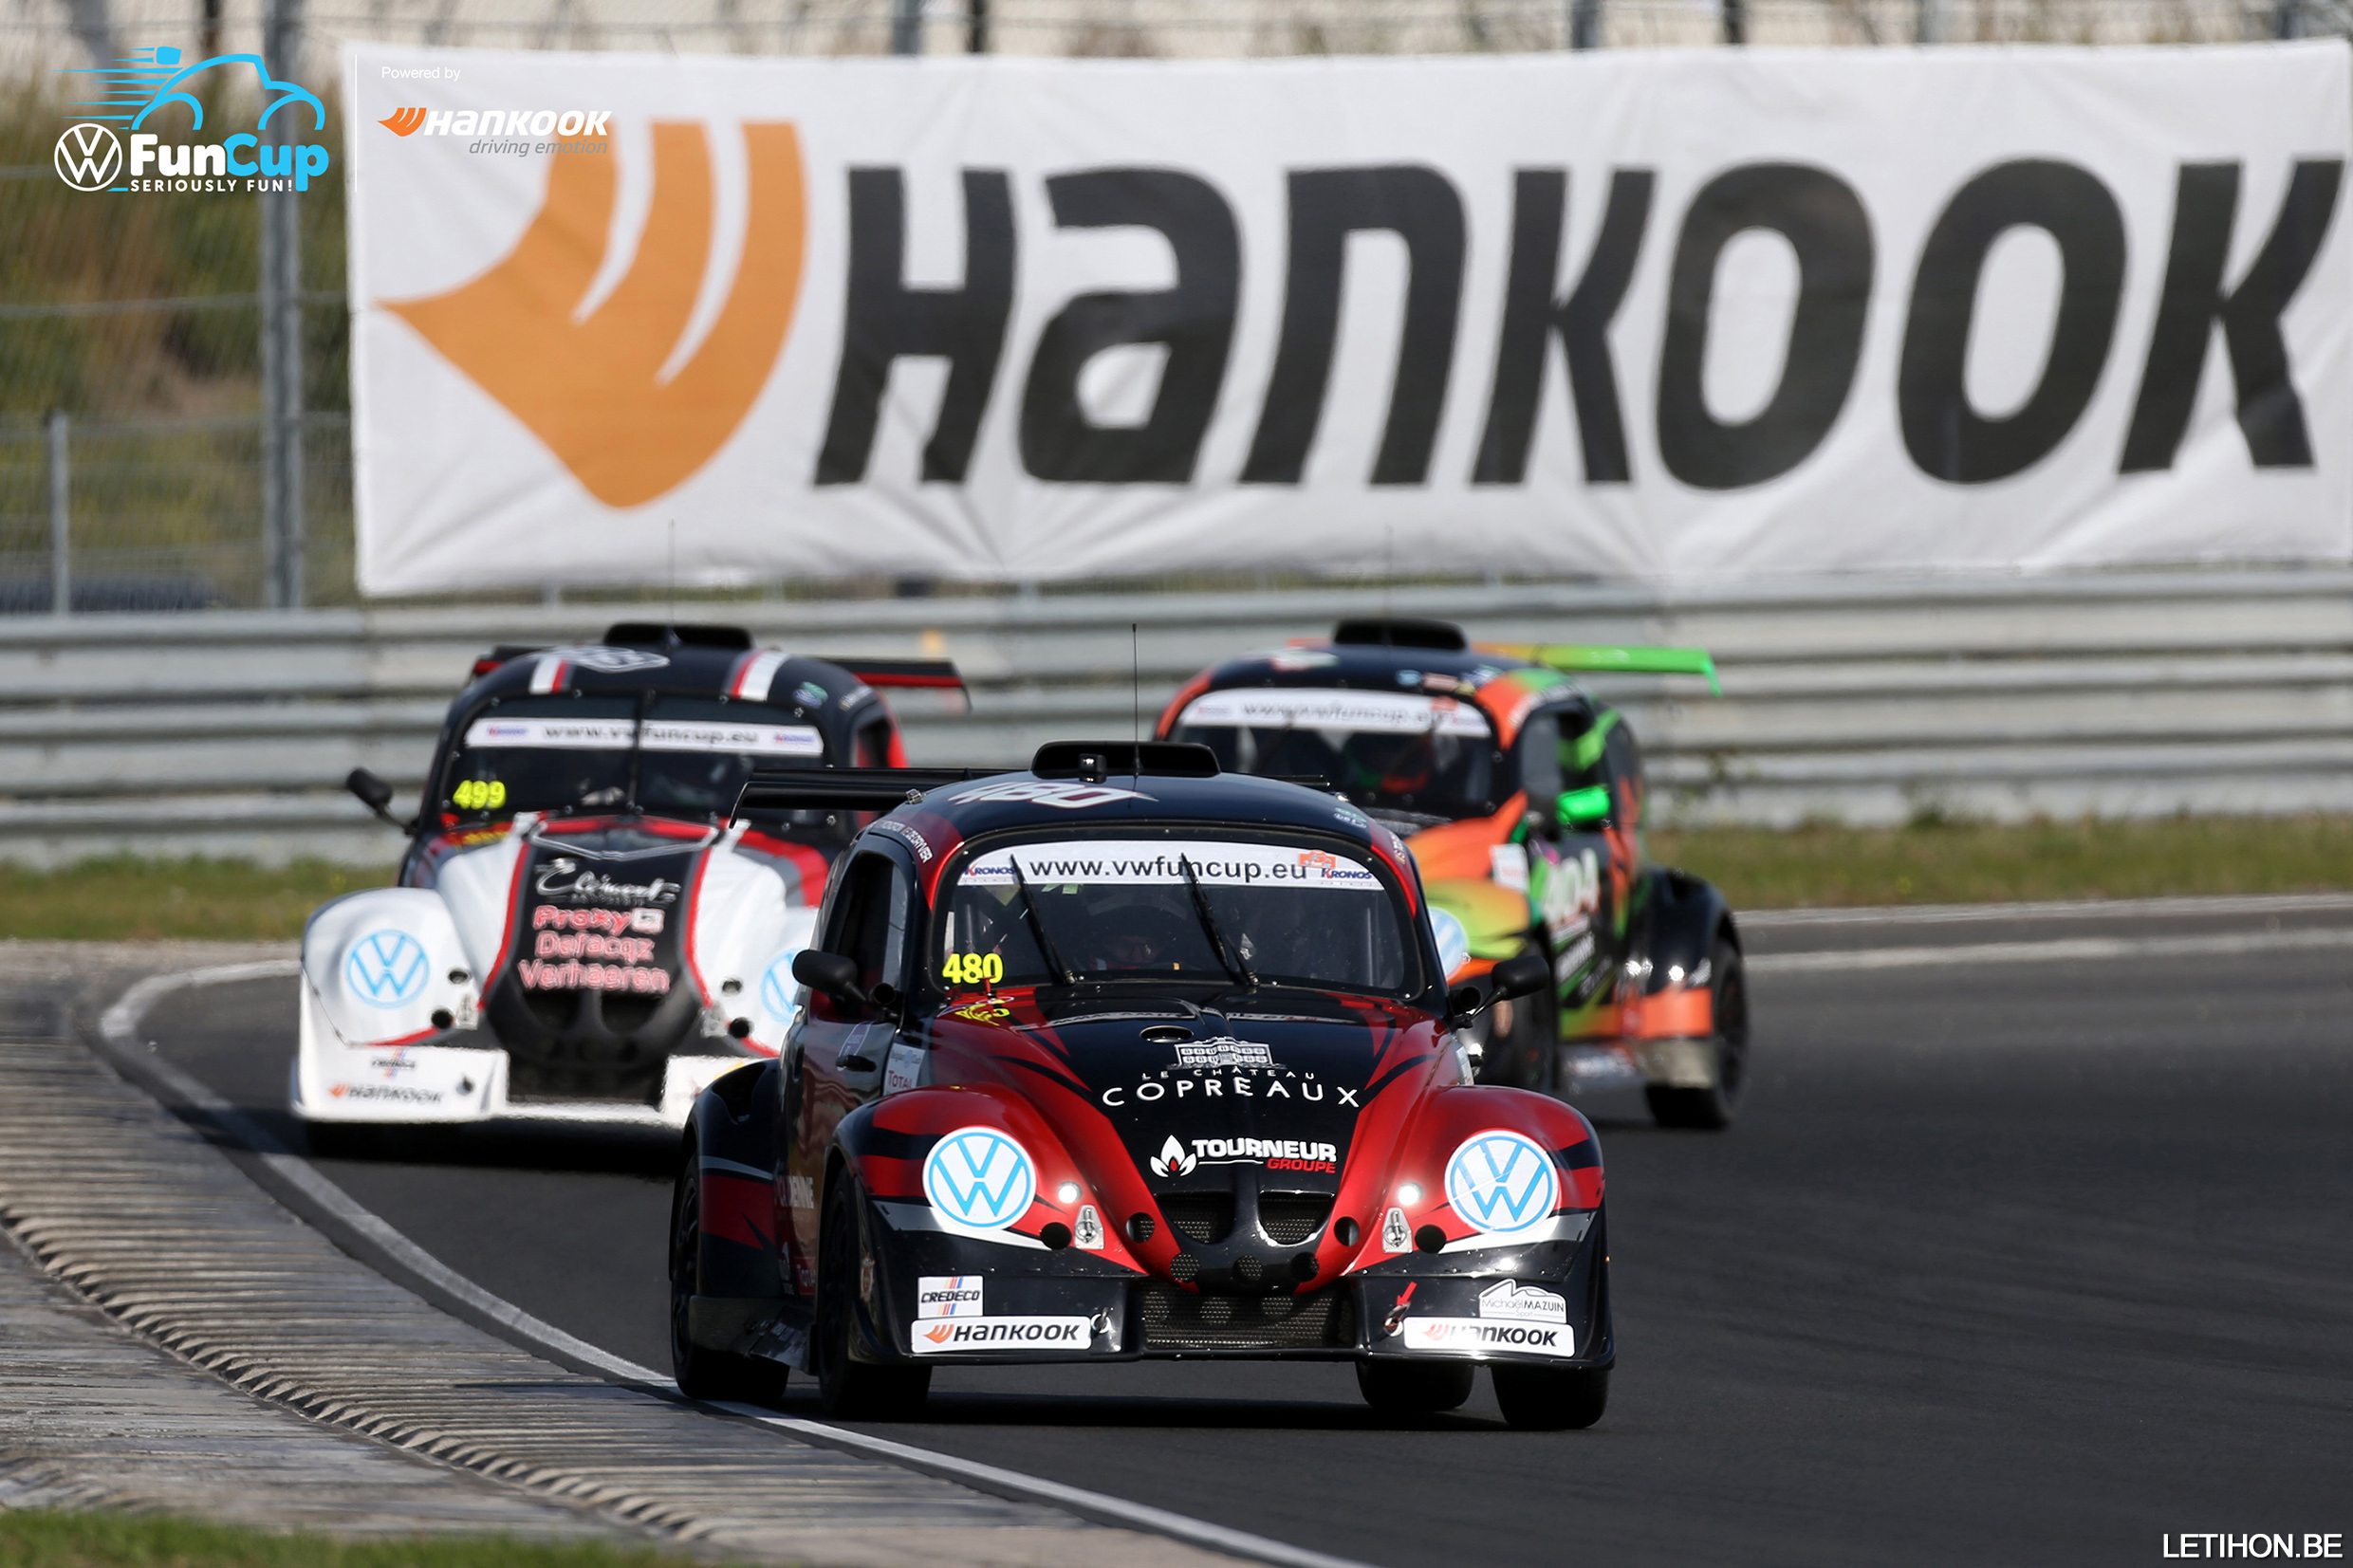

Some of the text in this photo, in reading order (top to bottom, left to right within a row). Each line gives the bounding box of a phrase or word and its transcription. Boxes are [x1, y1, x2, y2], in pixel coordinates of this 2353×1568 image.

[452, 780, 506, 809] 499
[1028, 855, 1307, 883] www.vwfuncup.eu
[1321, 867, 1373, 880] KRONOS
[532, 905, 632, 936] Proxy
[518, 958, 670, 993] Verhaeren
[941, 952, 1004, 984] 480
[1141, 1071, 1170, 1081] LE
[1102, 1076, 1360, 1108] COPREAUX
[1191, 1137, 1338, 1163] TOURNEUR
[1267, 1156, 1337, 1174] GROUPE
[920, 1289, 981, 1304] CREDECO
